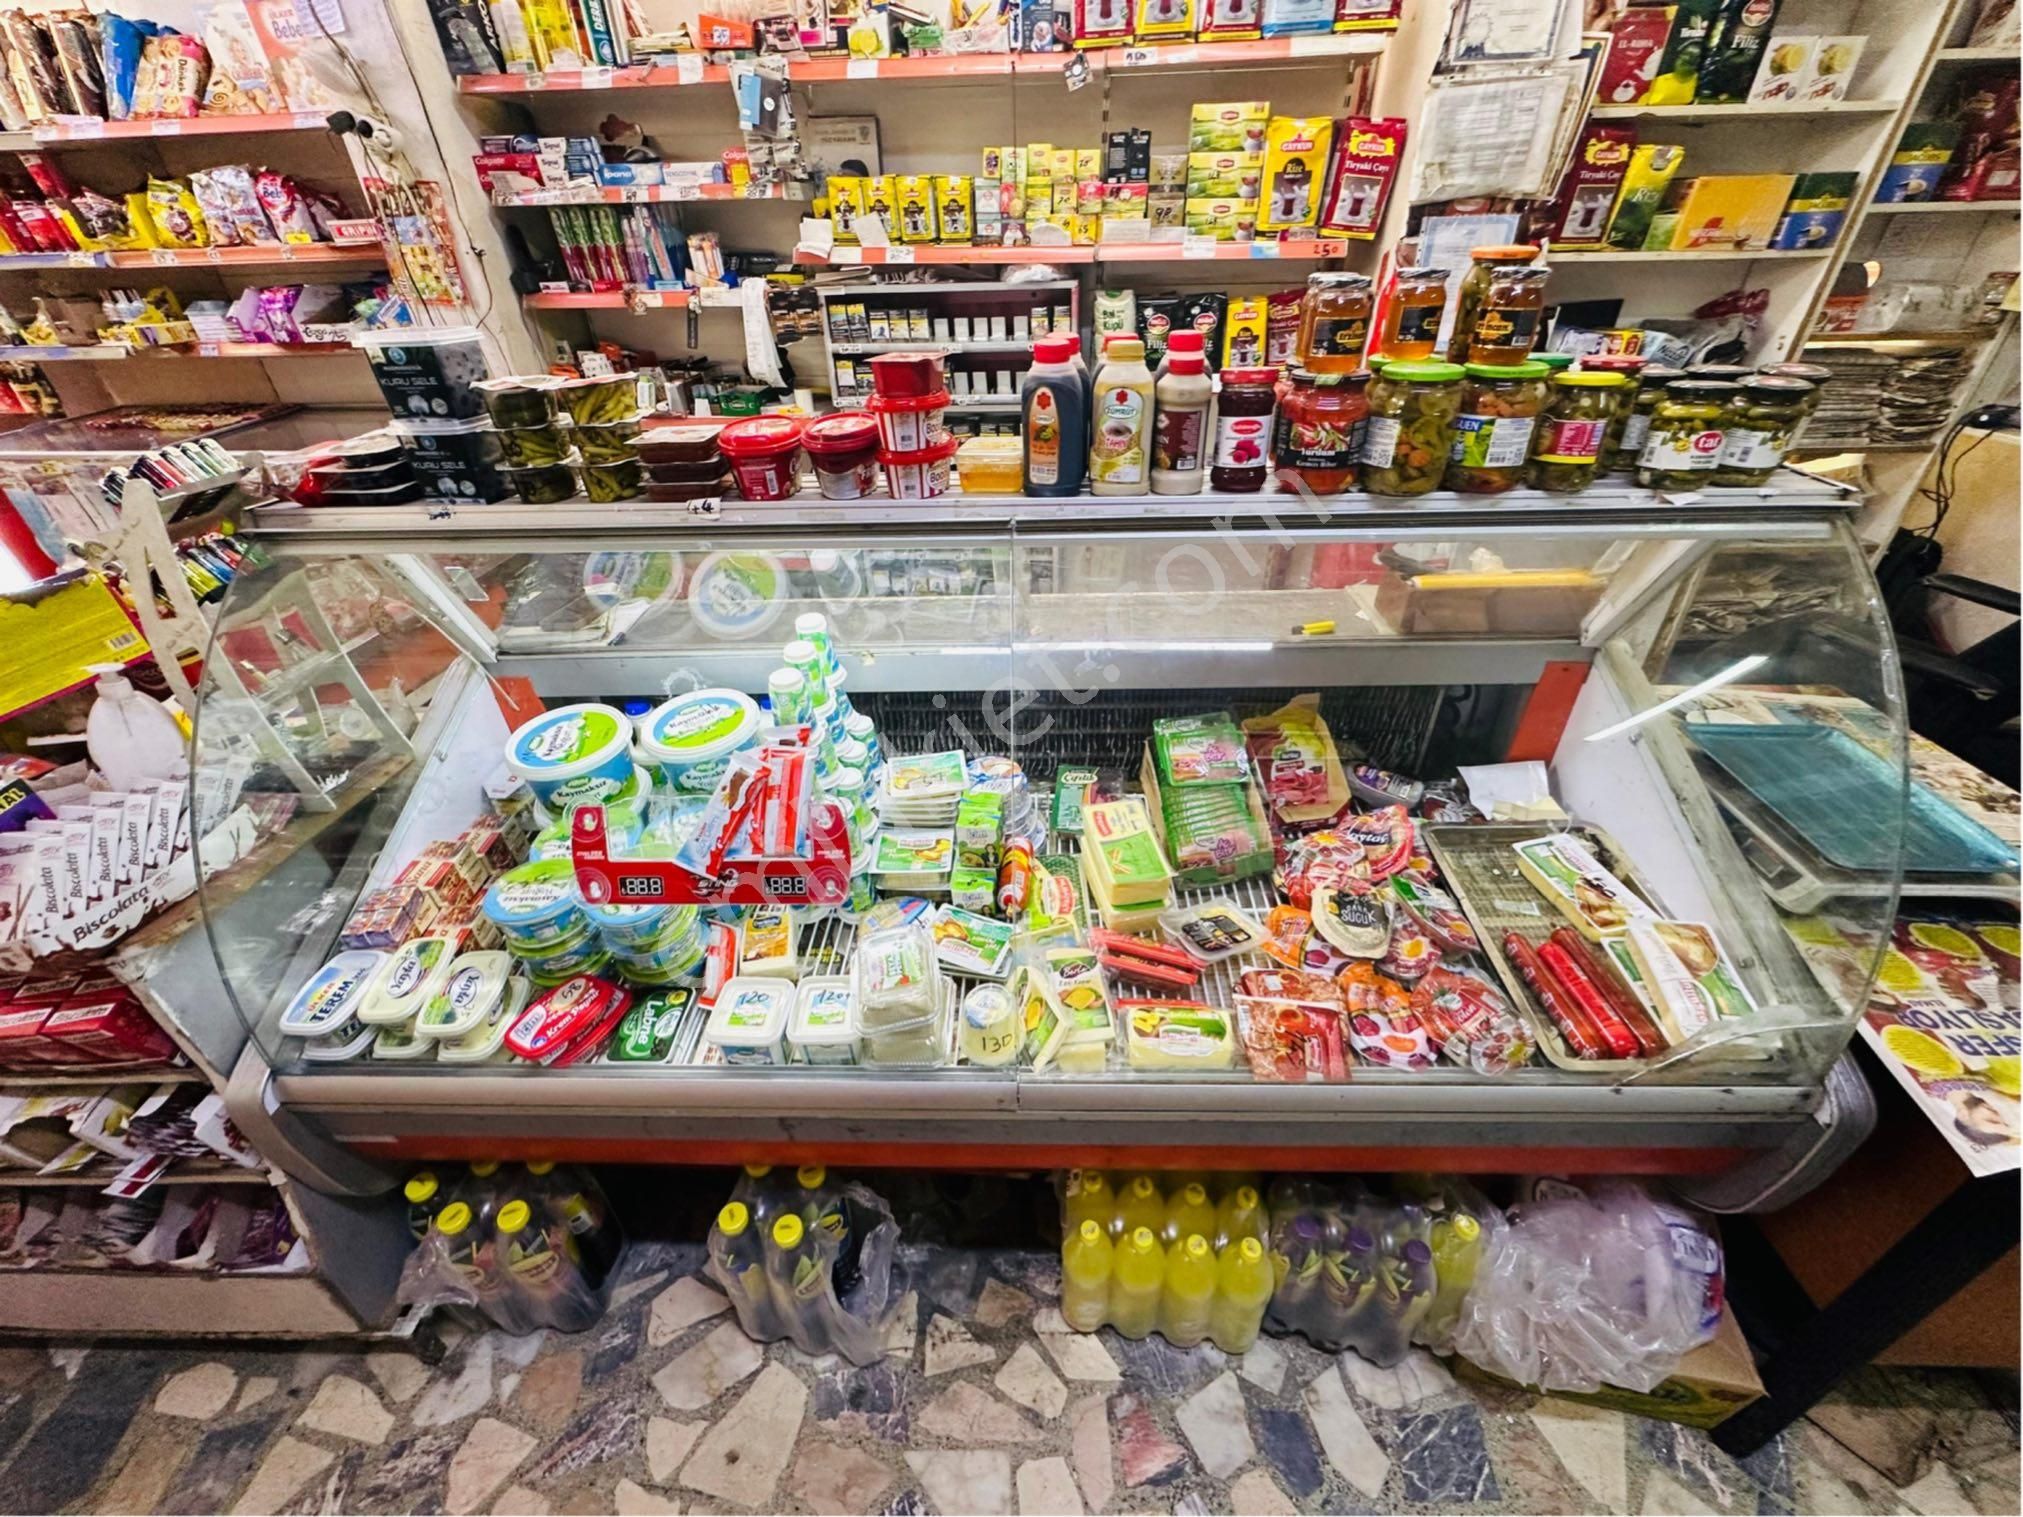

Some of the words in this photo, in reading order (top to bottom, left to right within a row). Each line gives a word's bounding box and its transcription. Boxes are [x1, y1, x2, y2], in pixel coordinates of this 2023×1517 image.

[1730, 33, 1761, 51] Filiz
[129, 821, 142, 867] Biscolata
[156, 806, 172, 852] Biscolata
[67, 851, 85, 899] Biscolata
[99, 836, 114, 883] Biscolata
[42, 865, 61, 914] Biscolata
[72, 885, 150, 943] Biscolata
[309, 979, 354, 1024] TEREM
[638, 999, 664, 1046] Labne
